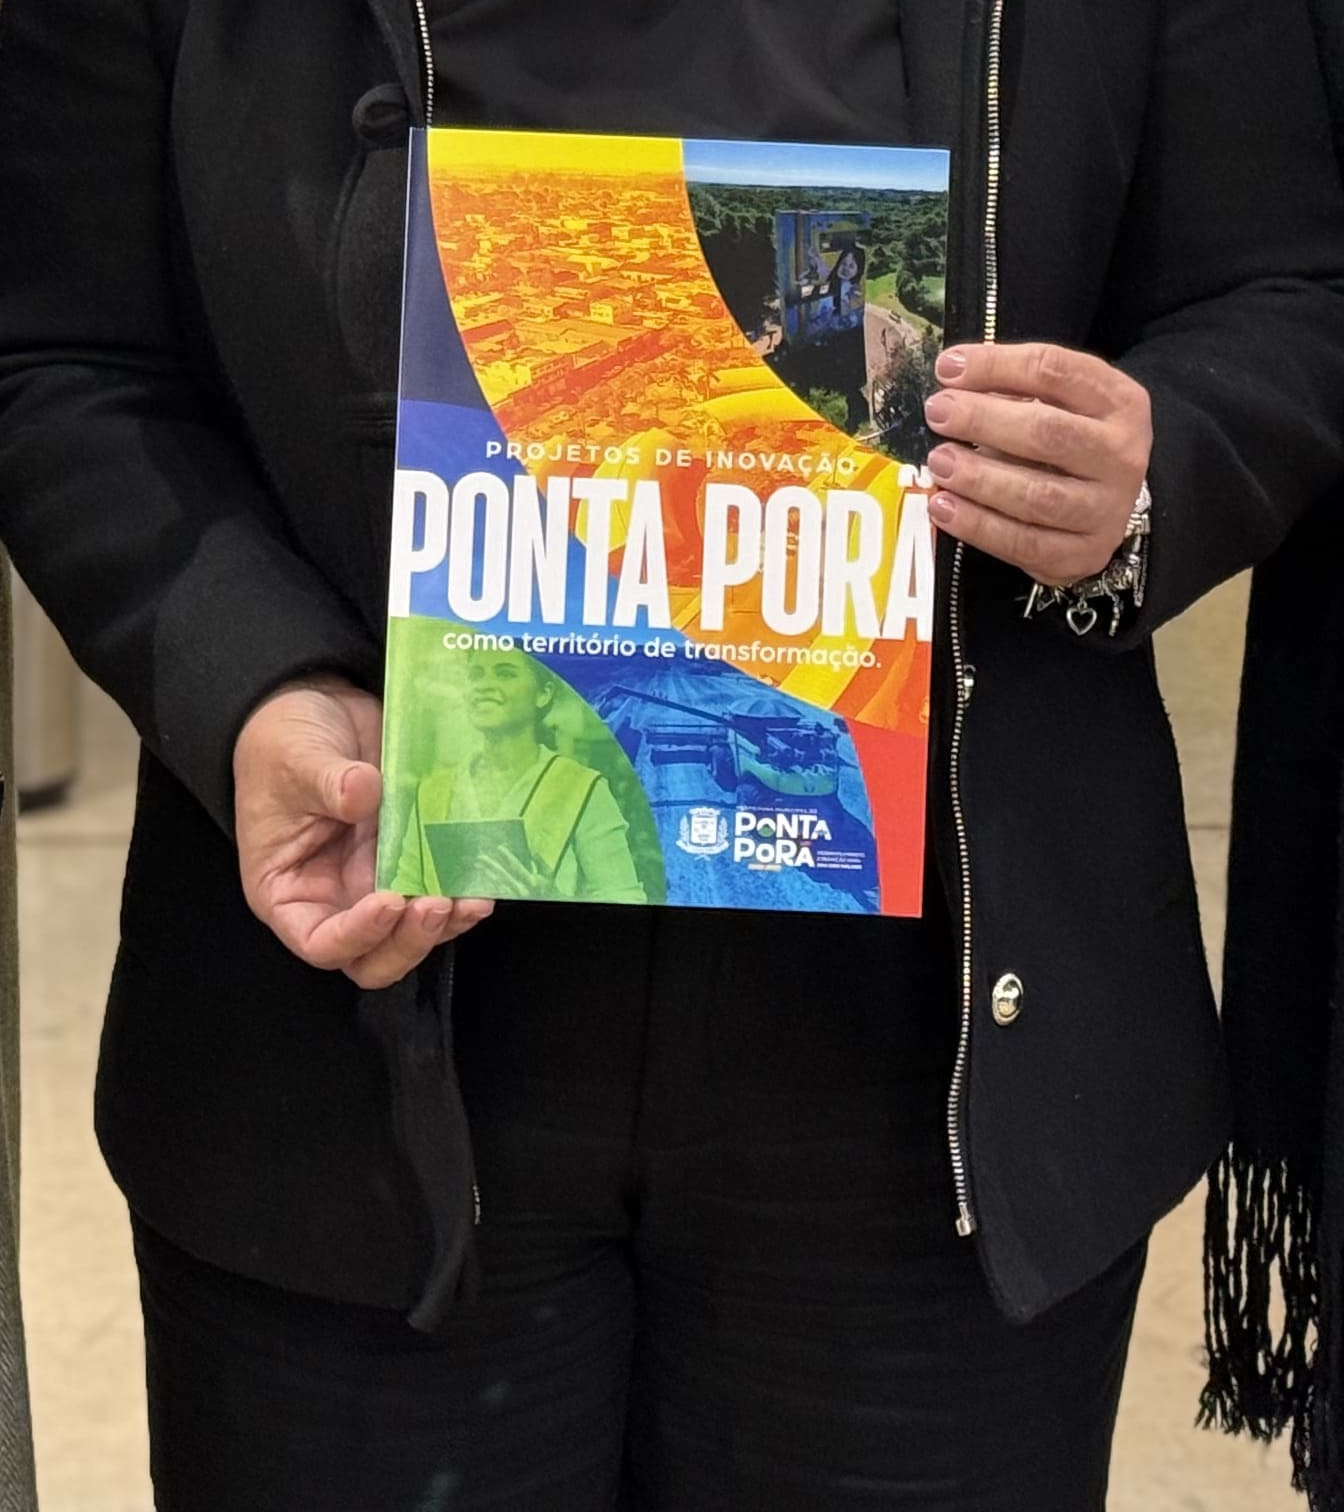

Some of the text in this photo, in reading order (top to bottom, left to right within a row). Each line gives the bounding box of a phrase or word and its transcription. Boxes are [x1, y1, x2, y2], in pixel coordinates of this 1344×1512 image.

[486, 441, 856, 474] PROJETOS DE INOVAÇÃO
[389, 465, 935, 642] PONTA PORÃ
[442, 632, 882, 670] como território de transformação.
